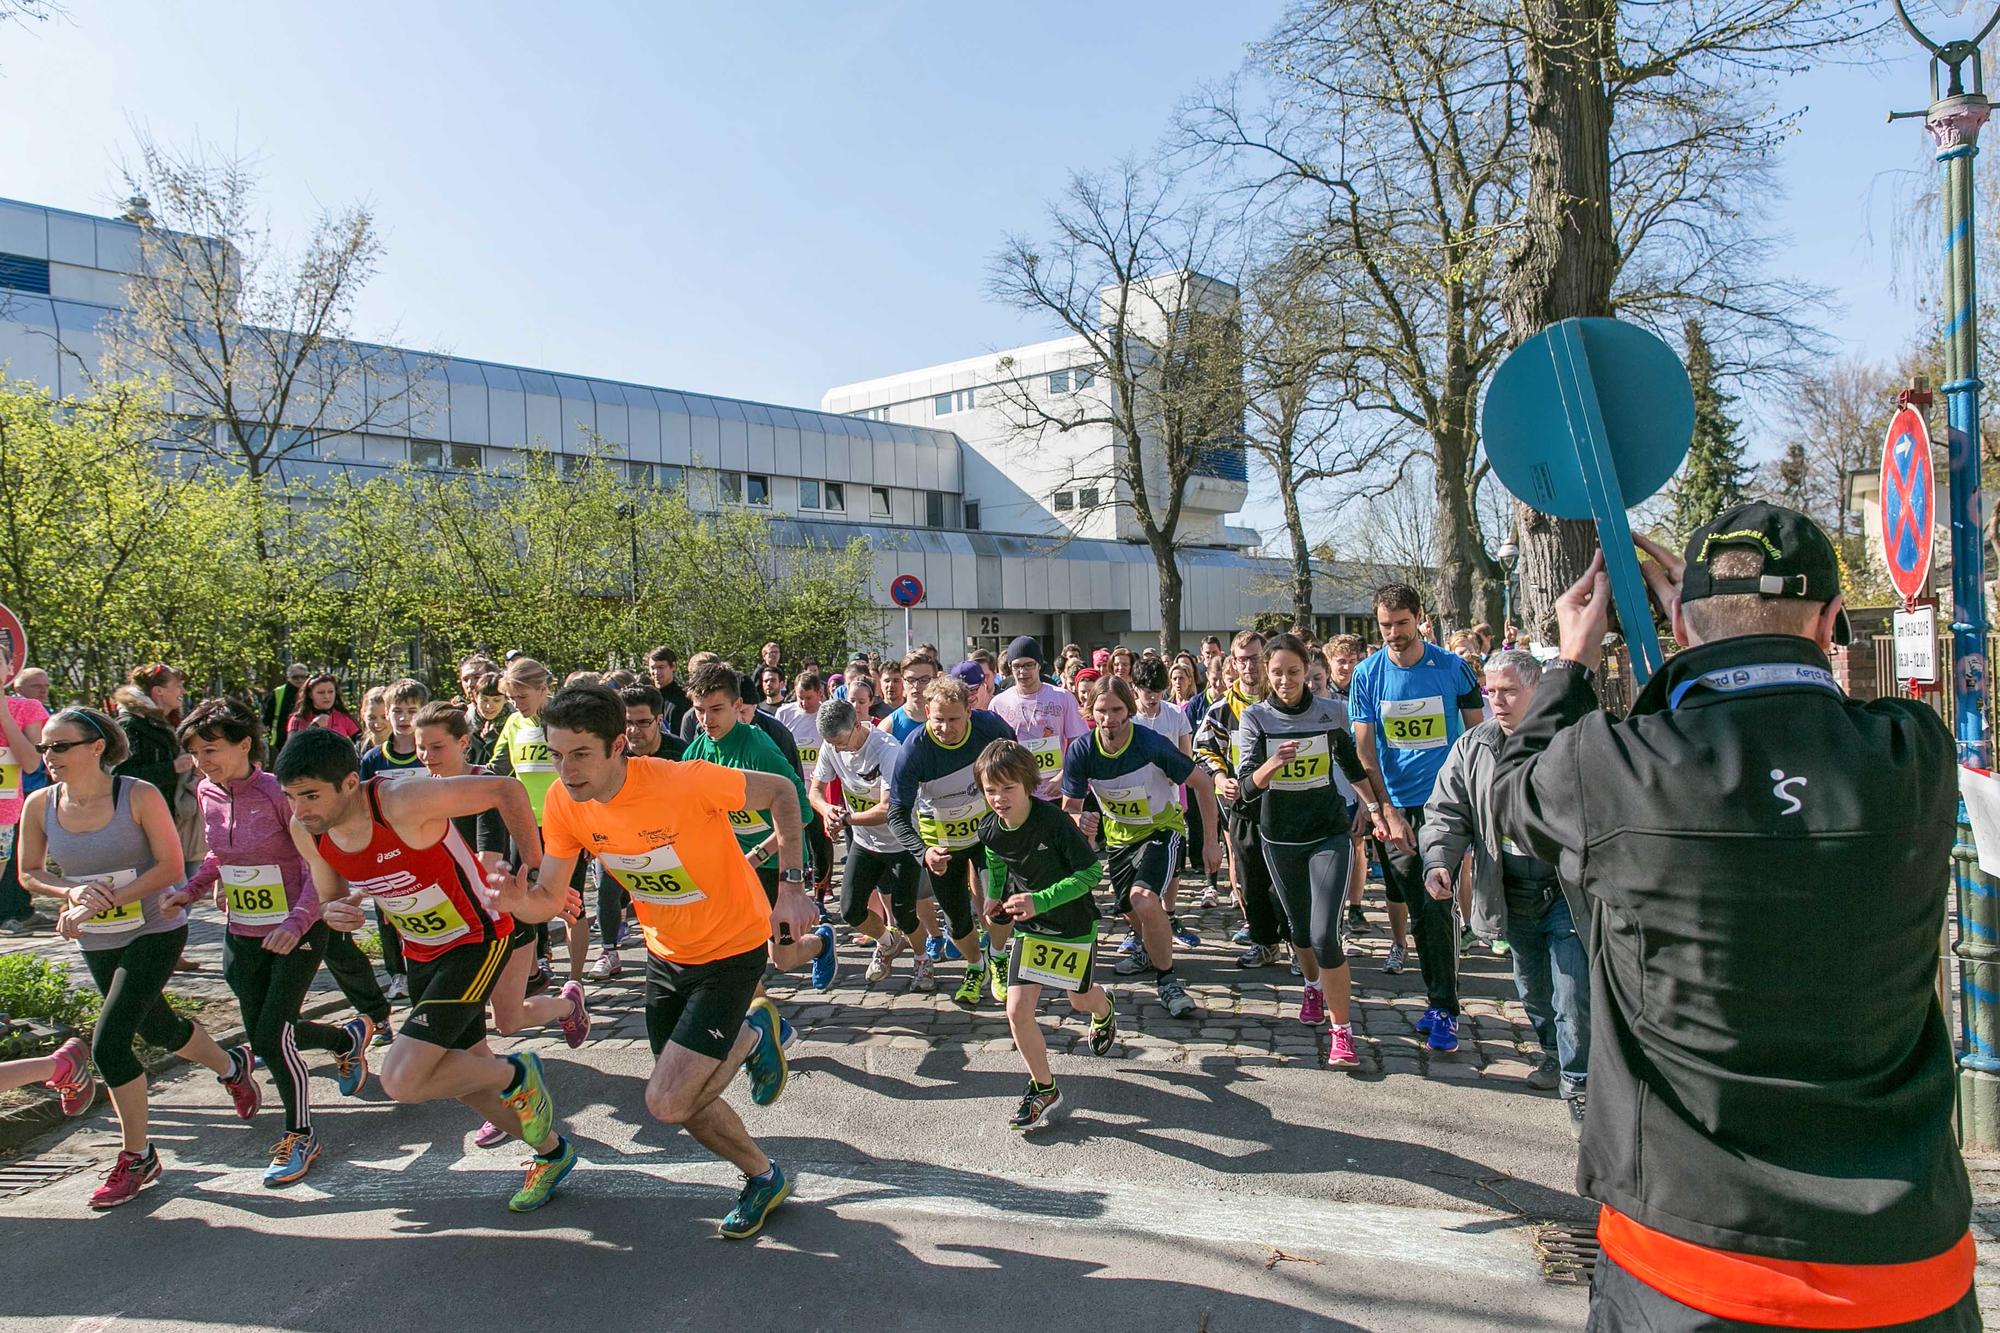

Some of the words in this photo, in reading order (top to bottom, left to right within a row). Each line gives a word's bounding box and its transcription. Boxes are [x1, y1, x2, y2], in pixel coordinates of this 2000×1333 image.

[981, 616, 1000, 635] 26
[1393, 718, 1434, 737] 367
[520, 744, 548, 761] 172
[801, 749, 817, 761] 10
[1035, 752, 1055, 769] 98
[1281, 757, 1319, 778] 157
[729, 810, 751, 824] 69
[1107, 801, 1141, 816] 274
[945, 817, 979, 837] 230
[384, 848, 401, 860] asics
[626, 873, 681, 892] 256
[233, 888, 273, 910] 168
[393, 911, 447, 934] 285
[1033, 944, 1078, 974] 374
